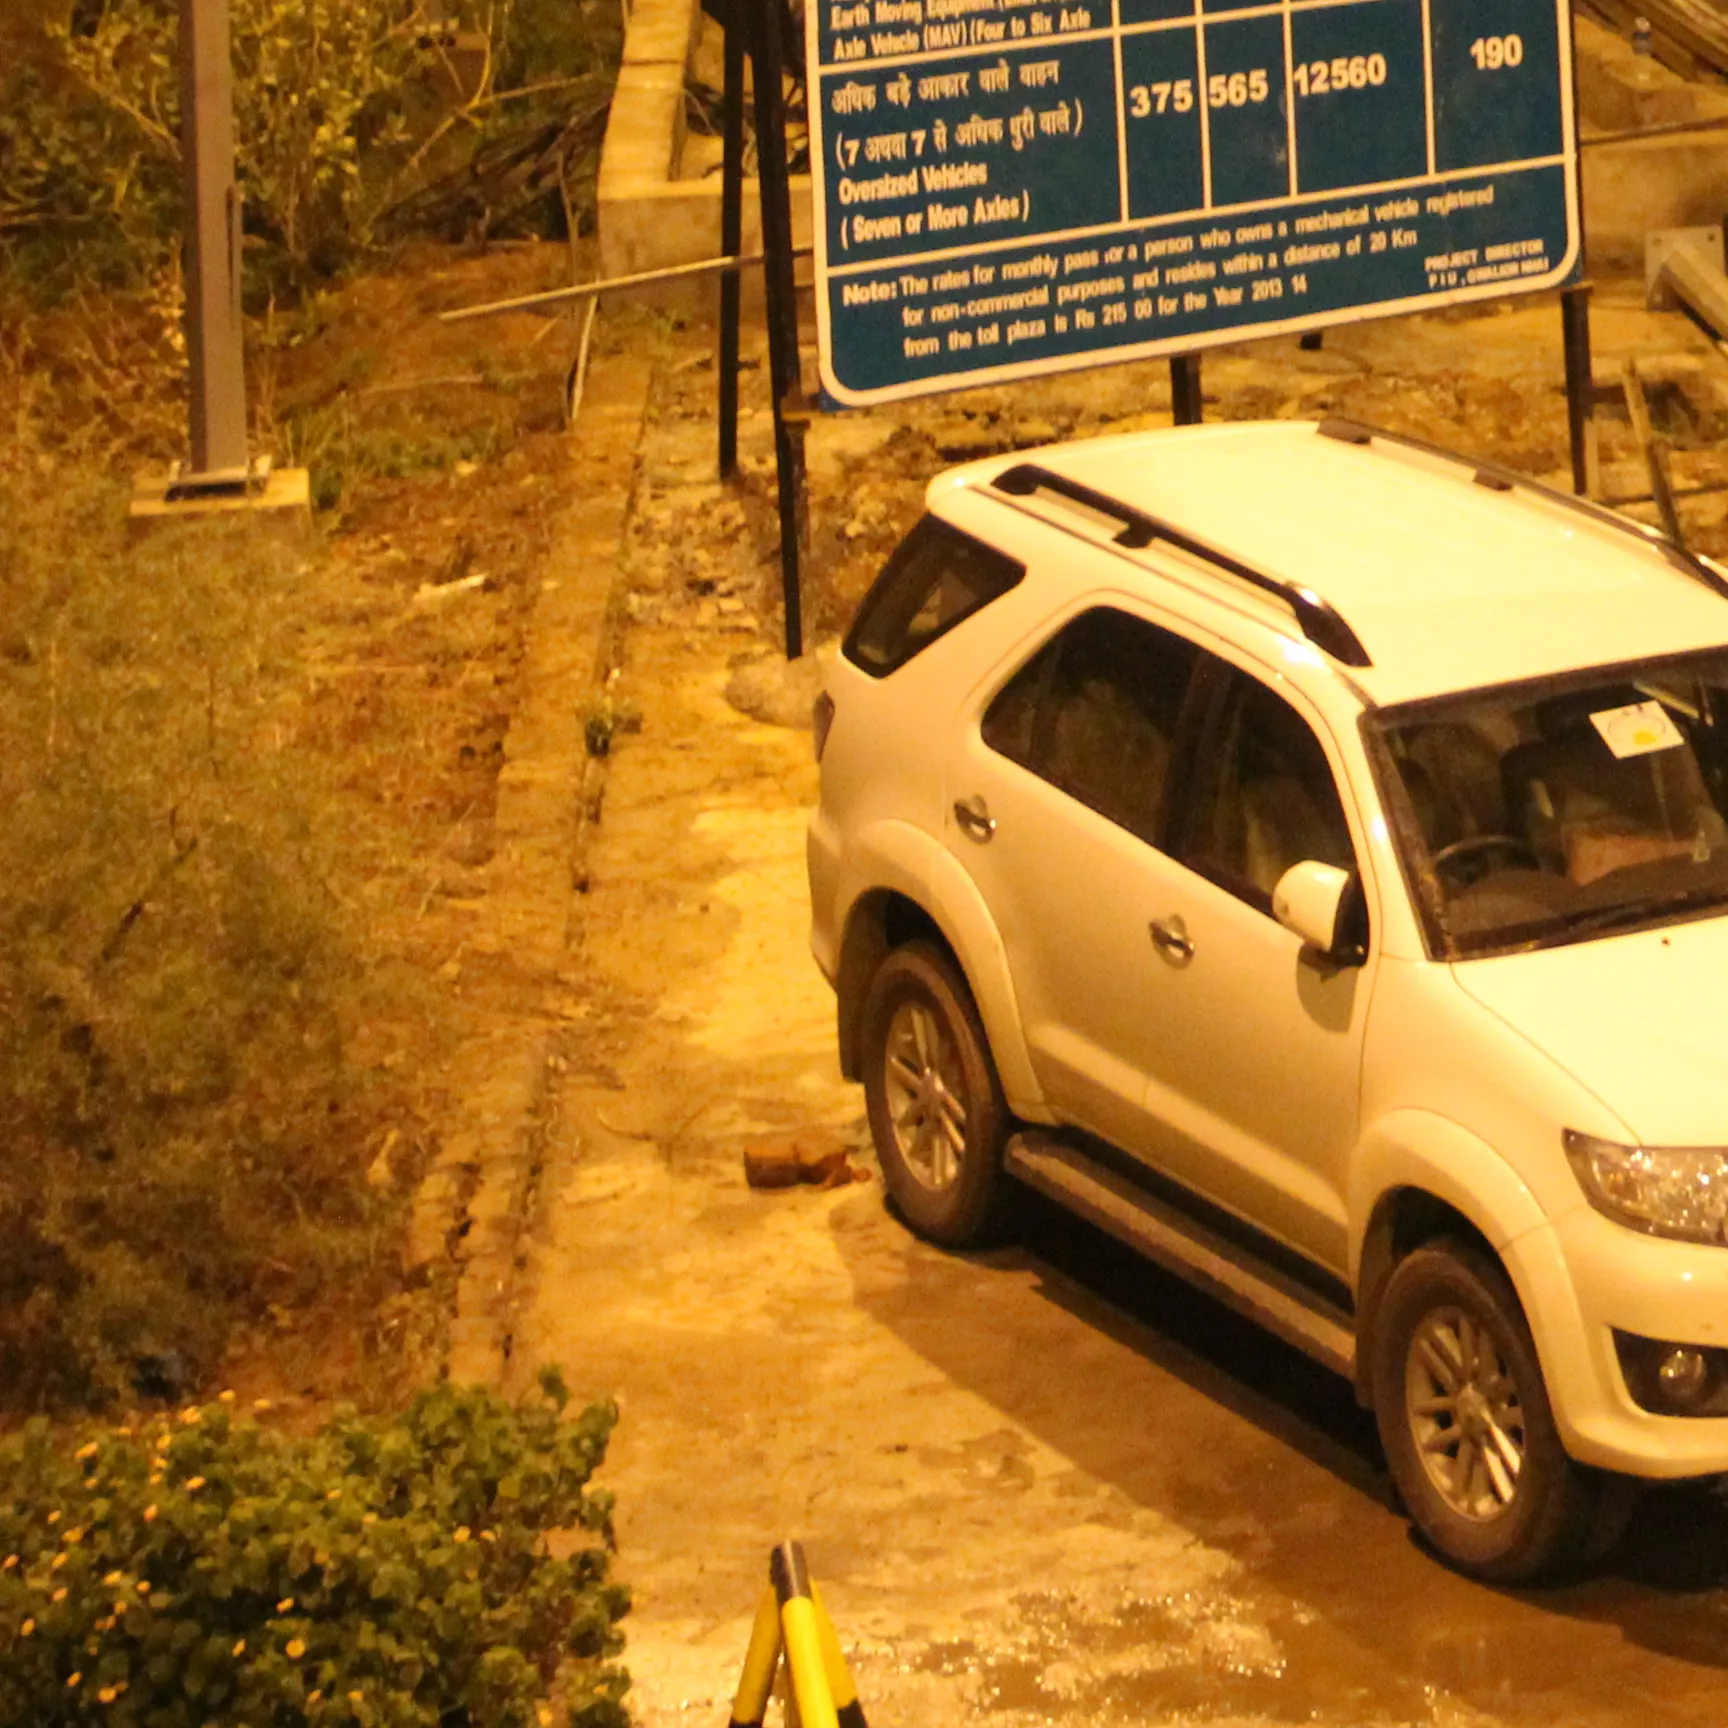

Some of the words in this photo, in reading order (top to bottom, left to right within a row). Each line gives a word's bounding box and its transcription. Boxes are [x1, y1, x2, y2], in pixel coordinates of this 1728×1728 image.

[923, 20, 968, 51] (MAV)
[1129, 79, 1193, 118] 375
[1208, 69, 1268, 108] 565
[1294, 53, 1387, 96] 12560
[1470, 34, 1523, 69] 190
[839, 168, 918, 205] Oversized
[921, 162, 988, 193] Vehicles
[927, 203, 969, 230] More
[843, 279, 897, 307] Note:
[900, 275, 928, 296] The
[933, 269, 969, 291] rates
[1001, 255, 1058, 281] monthly
[1144, 236, 1193, 262] person
[1200, 226, 1231, 249] who
[1295, 204, 1370, 233] mechanical
[1374, 197, 1419, 222] vehicle
[902, 306, 924, 327] for
[1057, 275, 1126, 306] purposes
[1284, 242, 1340, 267] distance
[903, 335, 940, 359] from
[947, 328, 973, 351] the
[1006, 318, 1047, 344] plaza
[1183, 290, 1207, 311] the
[1251, 277, 1283, 301] 2013
